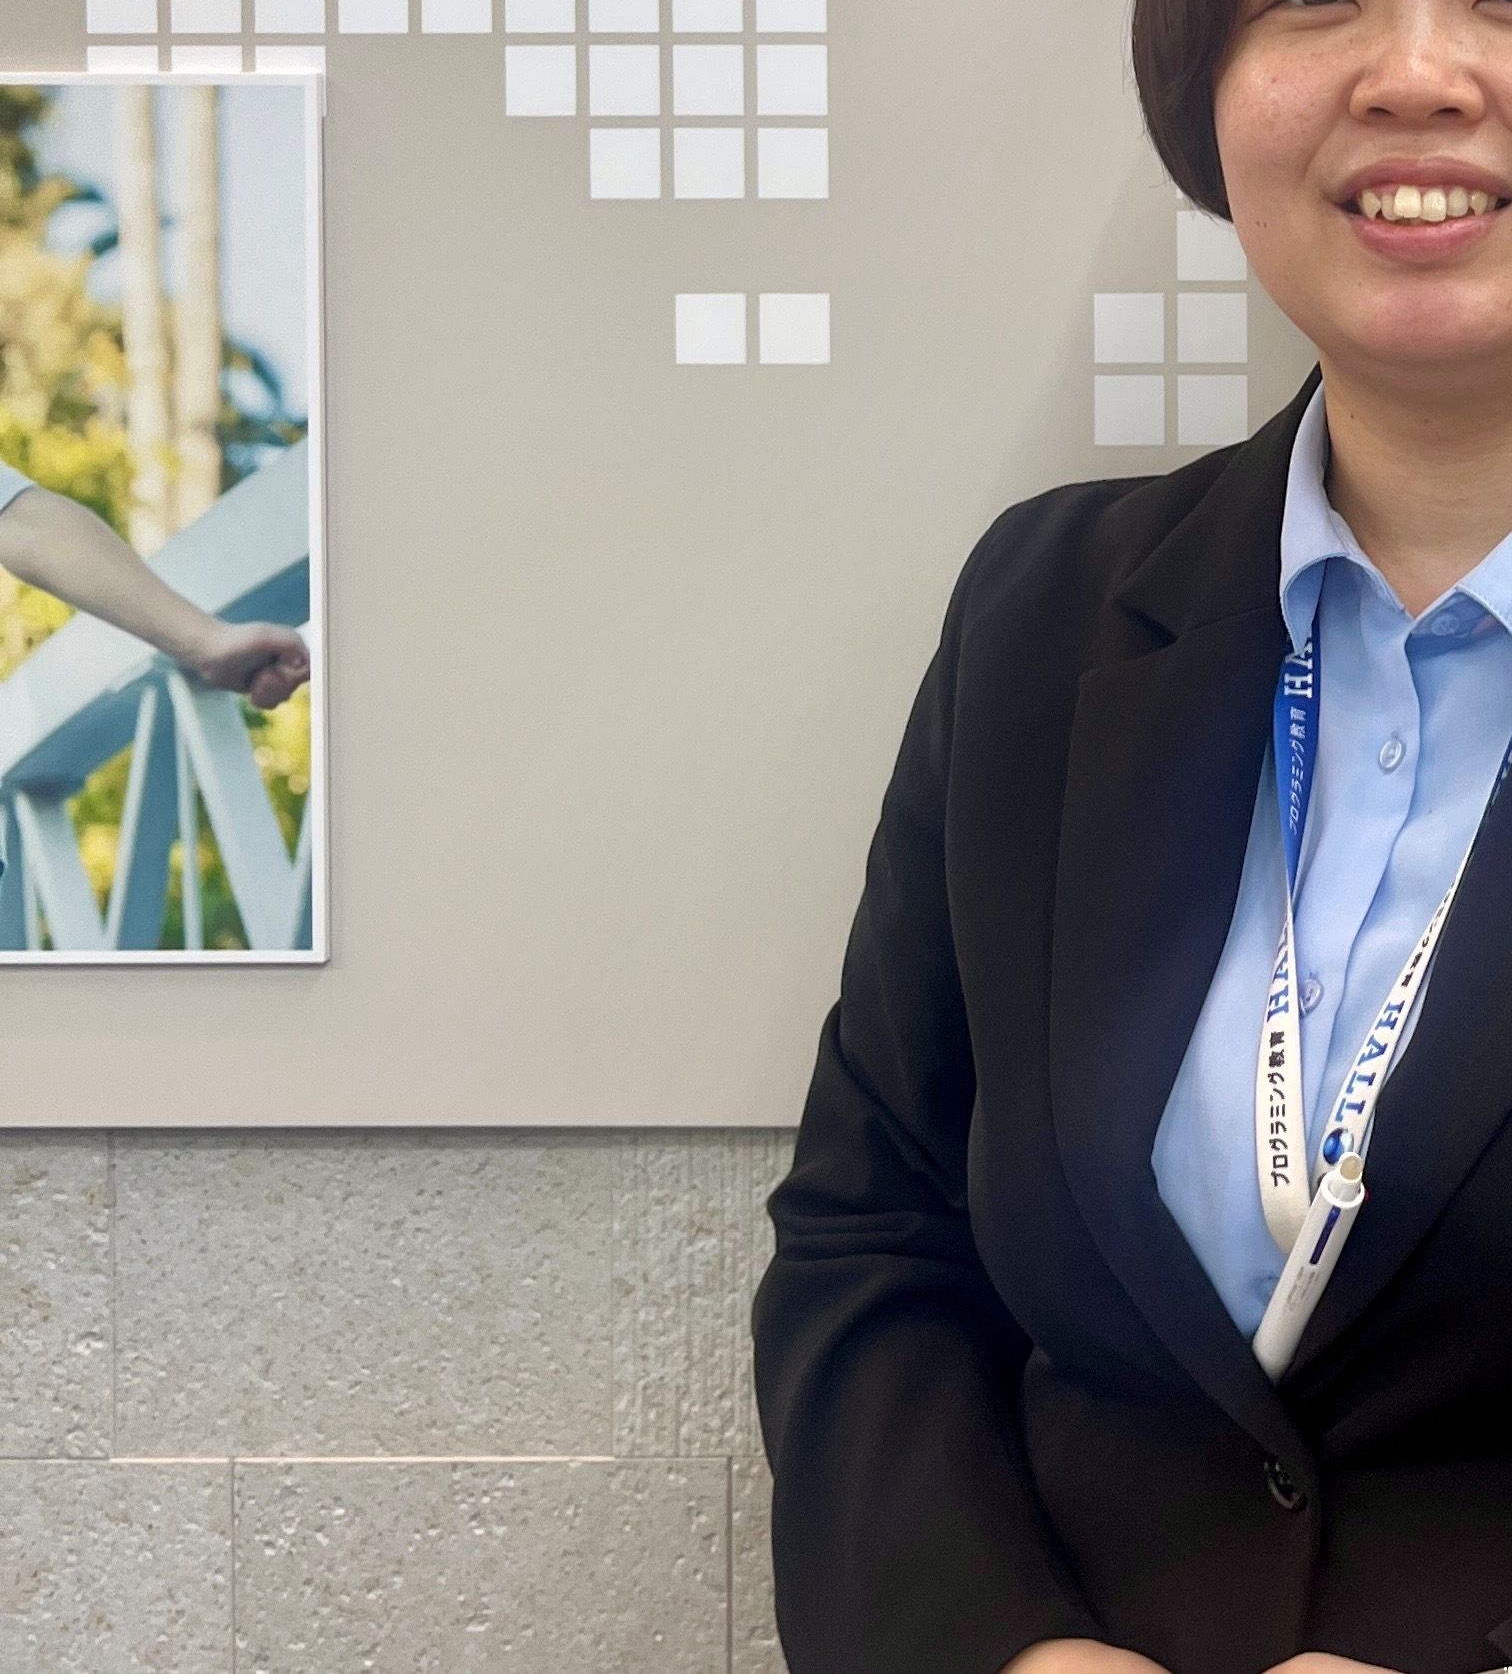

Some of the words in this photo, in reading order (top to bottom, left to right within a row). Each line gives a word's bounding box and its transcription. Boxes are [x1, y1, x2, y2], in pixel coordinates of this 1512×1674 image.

[1288, 706, 1307, 836] プログラミング教育
[1267, 1030, 1290, 1188] プログラミング教育
[1335, 1000, 1405, 1122] HALL
